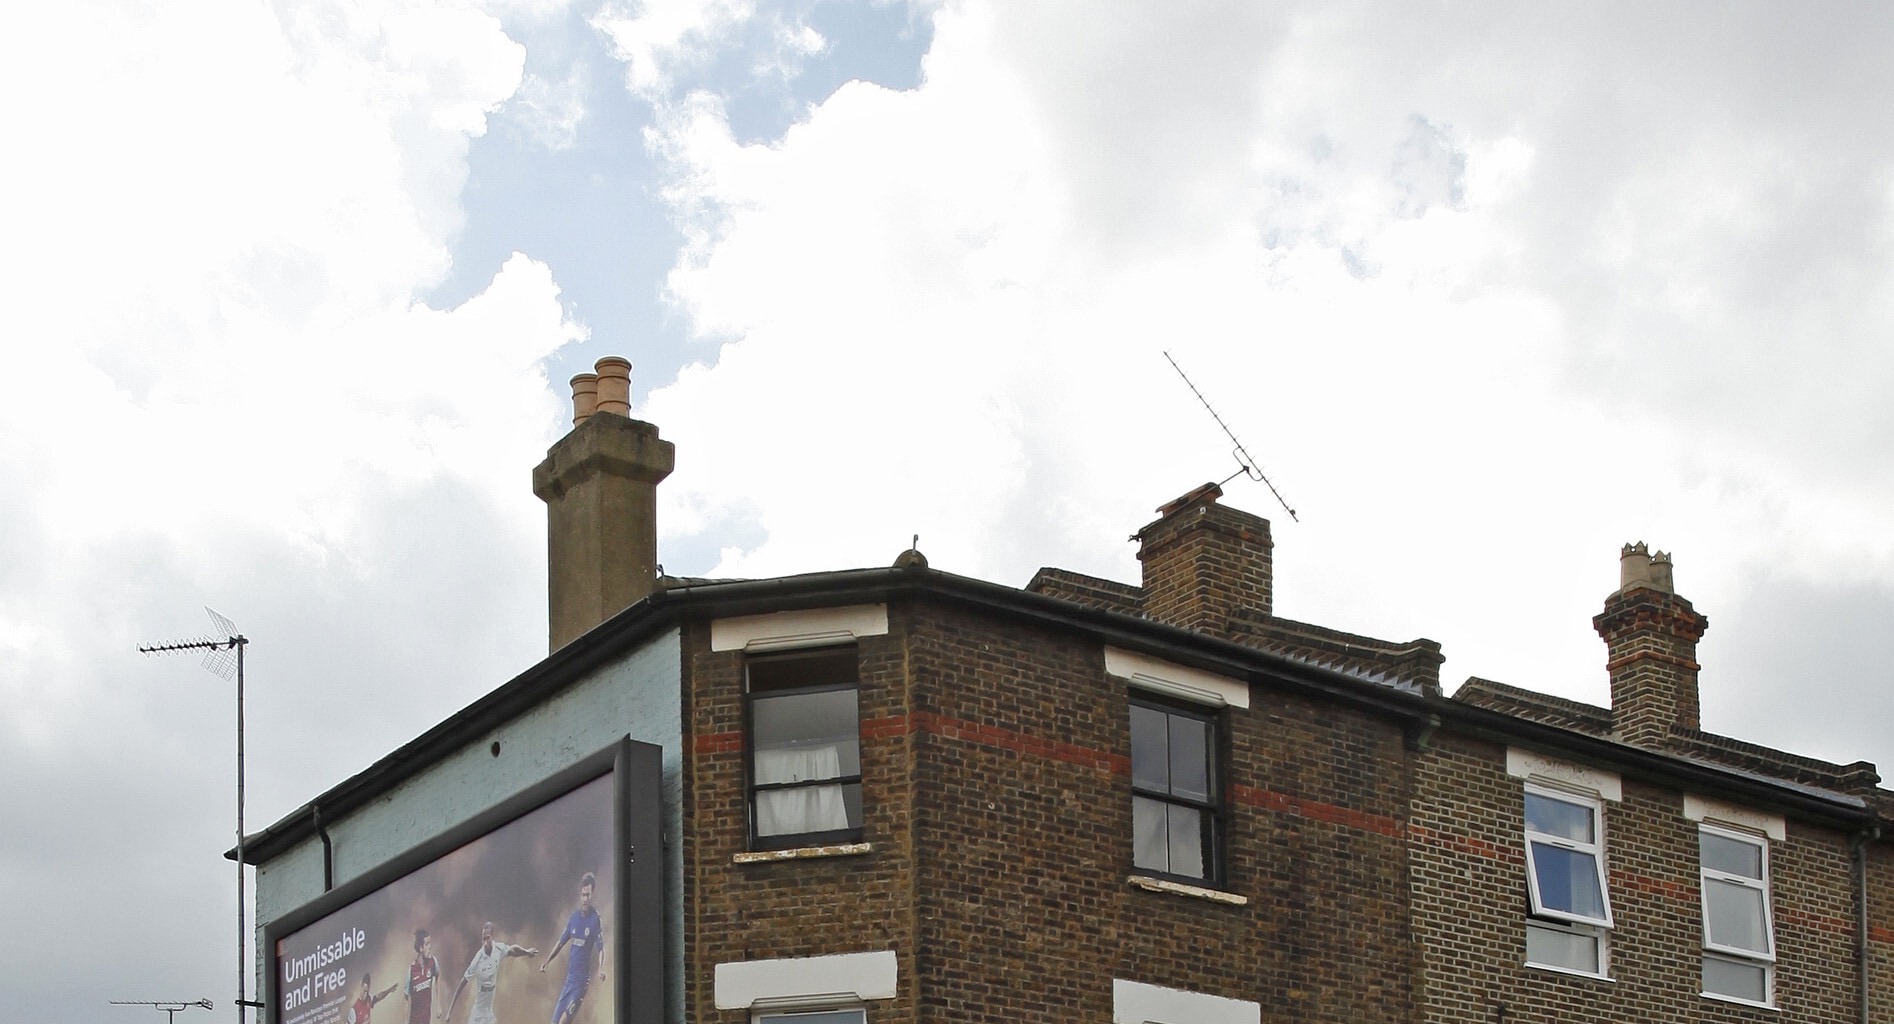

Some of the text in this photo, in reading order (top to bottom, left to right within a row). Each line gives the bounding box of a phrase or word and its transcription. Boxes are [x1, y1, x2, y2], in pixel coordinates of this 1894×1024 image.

[285, 927, 366, 983] Unmissable
[285, 978, 310, 1011] and
[314, 967, 346, 998] Free
